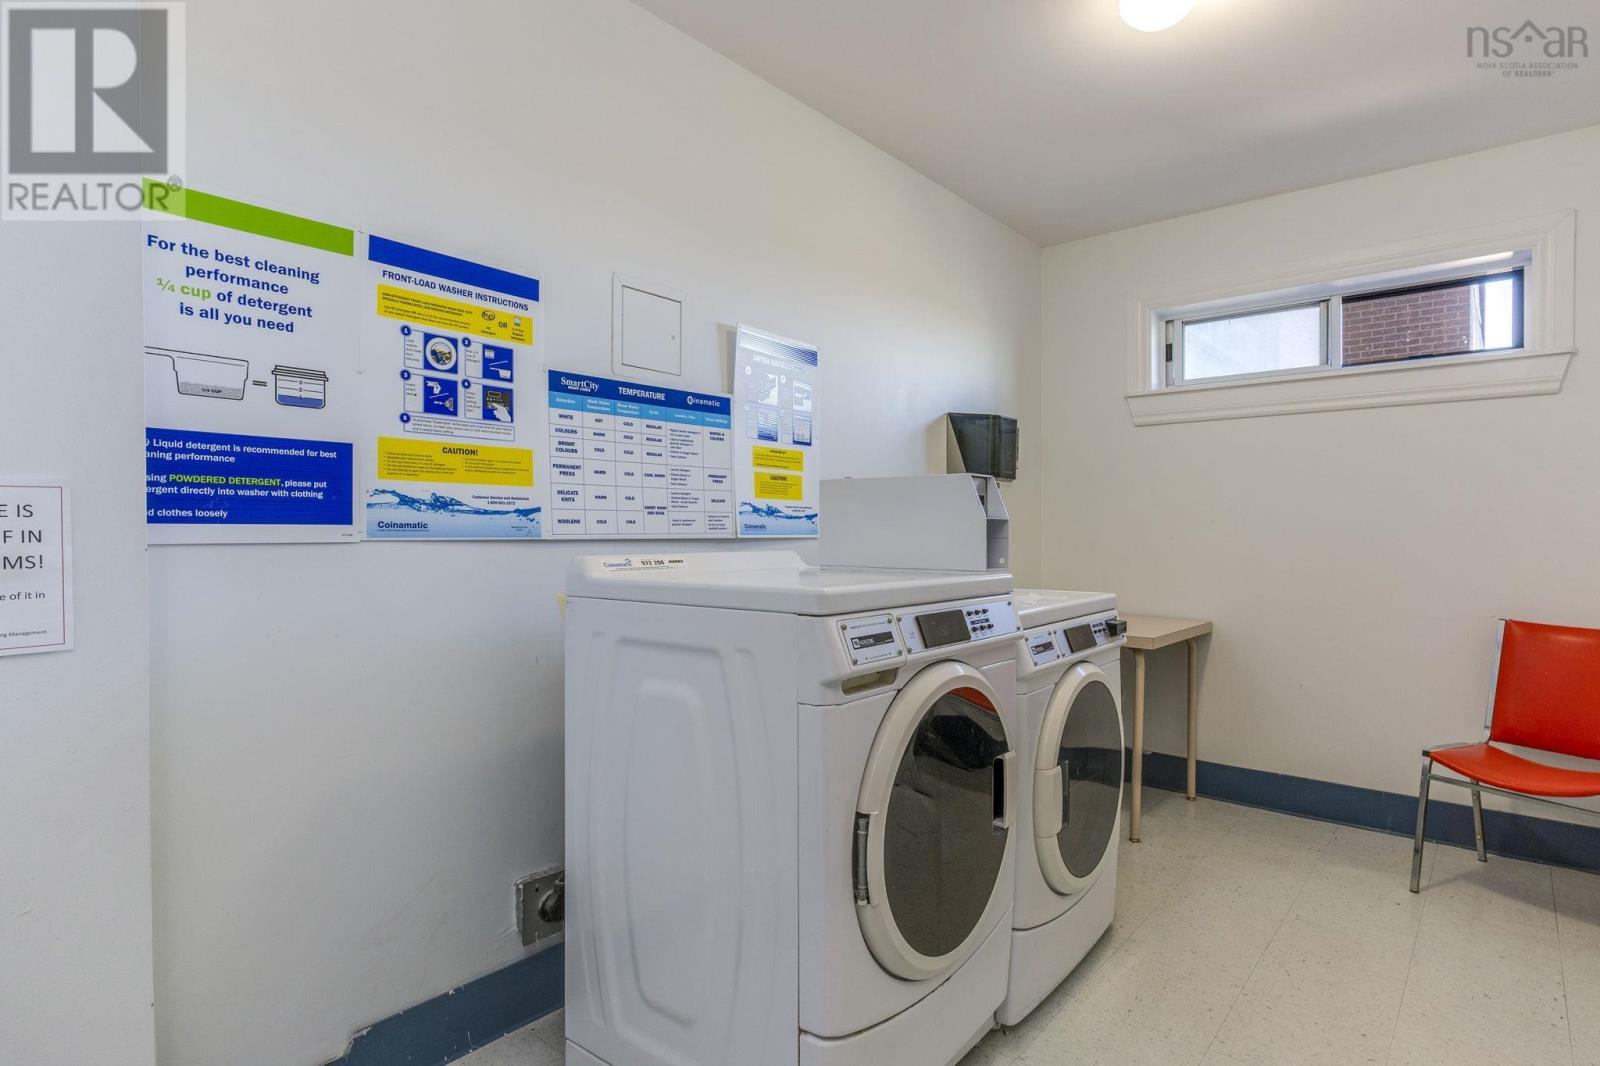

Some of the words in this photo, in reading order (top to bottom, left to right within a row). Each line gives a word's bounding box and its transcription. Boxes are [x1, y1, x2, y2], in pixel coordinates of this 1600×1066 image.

[147, 234, 176, 252] For
[180, 241, 209, 258] the
[214, 249, 250, 268] best
[254, 259, 320, 284] cleaning
[185, 265, 289, 295] performance
[382, 270, 437, 290] FRONT-LOAD
[438, 283, 473, 299] WASHER
[475, 292, 529, 311] INSTRUCTIONS
[180, 284, 212, 300] cup
[216, 291, 233, 303] of
[237, 293, 313, 318] detergent
[179, 302, 194, 316] is
[199, 307, 219, 321] all
[224, 313, 251, 326] you
[257, 318, 295, 333] need
[560, 376, 599, 392] SmartCity
[618, 386, 666, 401] TEMPERATURE
[153, 438, 183, 449] Liquid
[185, 441, 231, 452] detergent
[243, 445, 305, 456] recommended
[306, 448, 318, 457] for
[319, 449, 337, 458] best
[442, 447, 478, 456] CAUTION!
[174, 452, 236, 463] performance
[552, 463, 582, 471] PERMANENT
[169, 474, 226, 484] POWDERED
[284, 479, 312, 489] please
[313, 481, 327, 489] put
[180, 486, 215, 496] directly
[218, 487, 235, 495] into
[237, 488, 269, 497] washer
[271, 489, 289, 497] with
[290, 490, 324, 499] clothing
[16, 504, 34, 518] IS
[157, 508, 193, 517] clothes
[195, 509, 228, 519] loosely
[377, 520, 429, 529] Coinamatic
[21, 530, 42, 543] IN
[9, 592, 22, 600] of
[35, 592, 46, 600] in
[8, 629, 47, 638] Management
